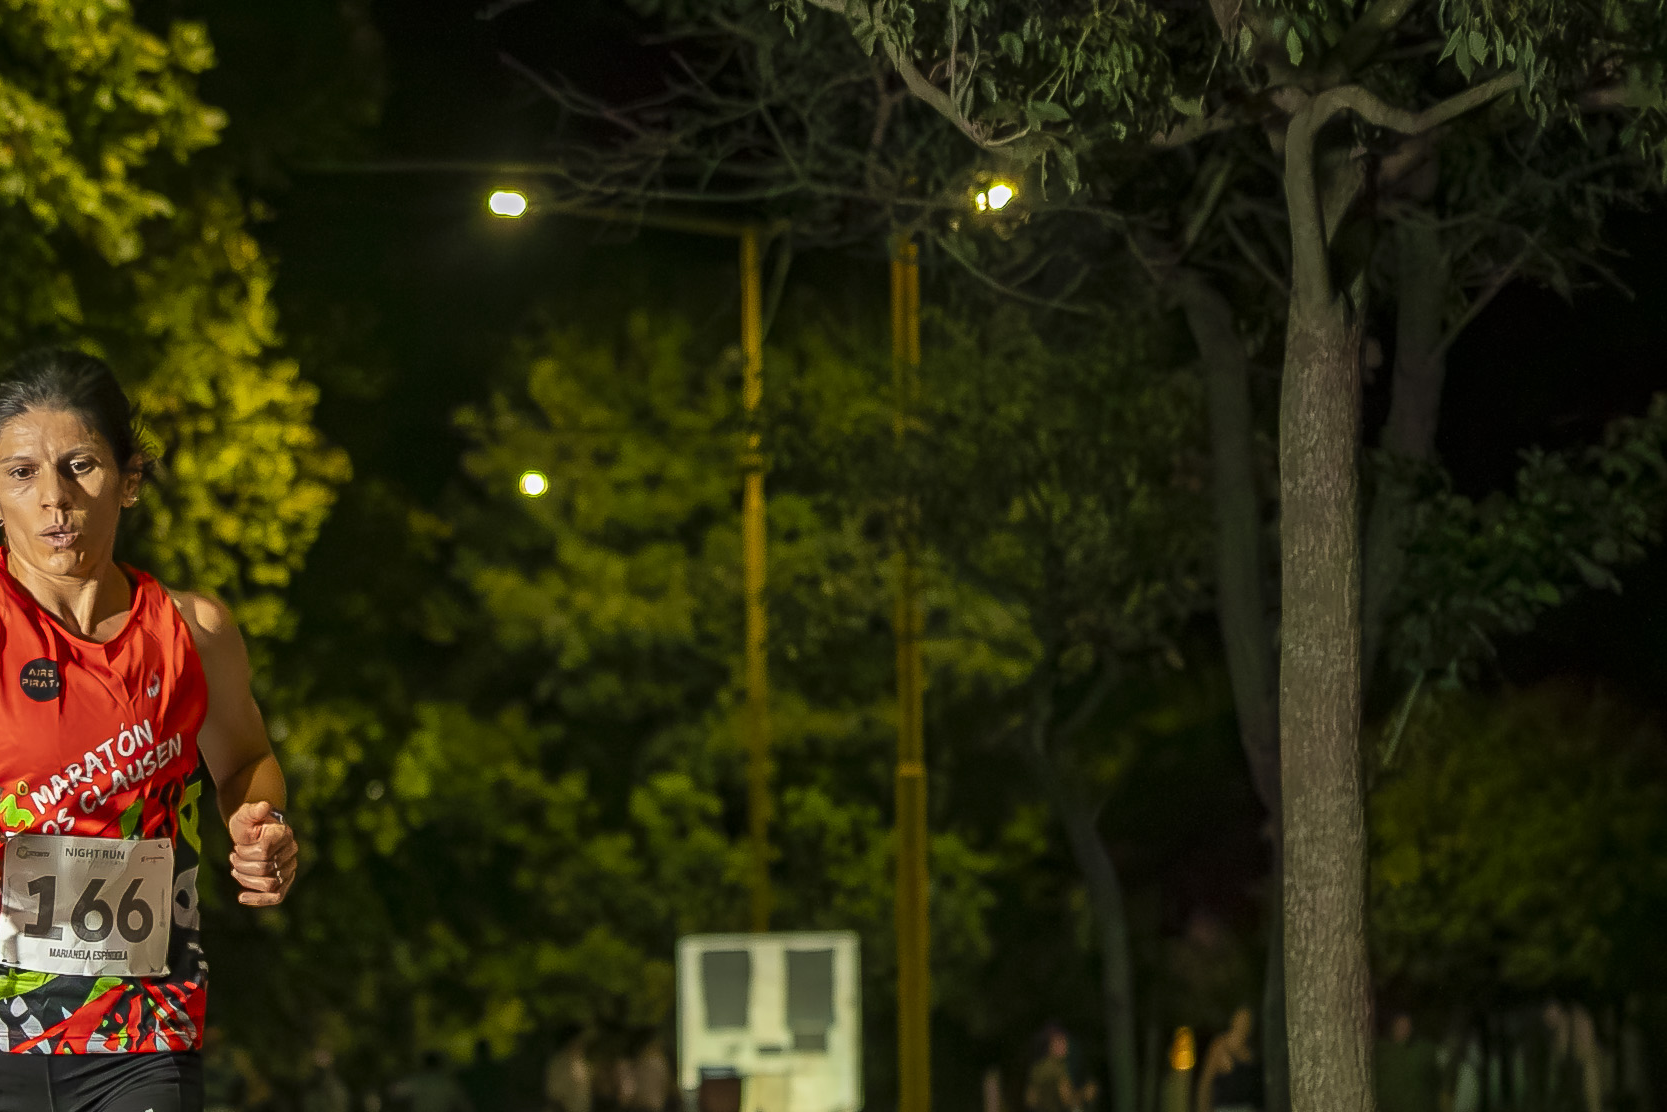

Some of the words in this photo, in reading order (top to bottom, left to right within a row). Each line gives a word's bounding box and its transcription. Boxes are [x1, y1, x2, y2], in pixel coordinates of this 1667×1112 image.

[30, 718, 154, 815] MARATÓN
[79, 732, 182, 814] CLAUSEN
[65, 847, 100, 859] NIGHT
[102, 849, 125, 860] RUN
[24, 875, 154, 943] 166
